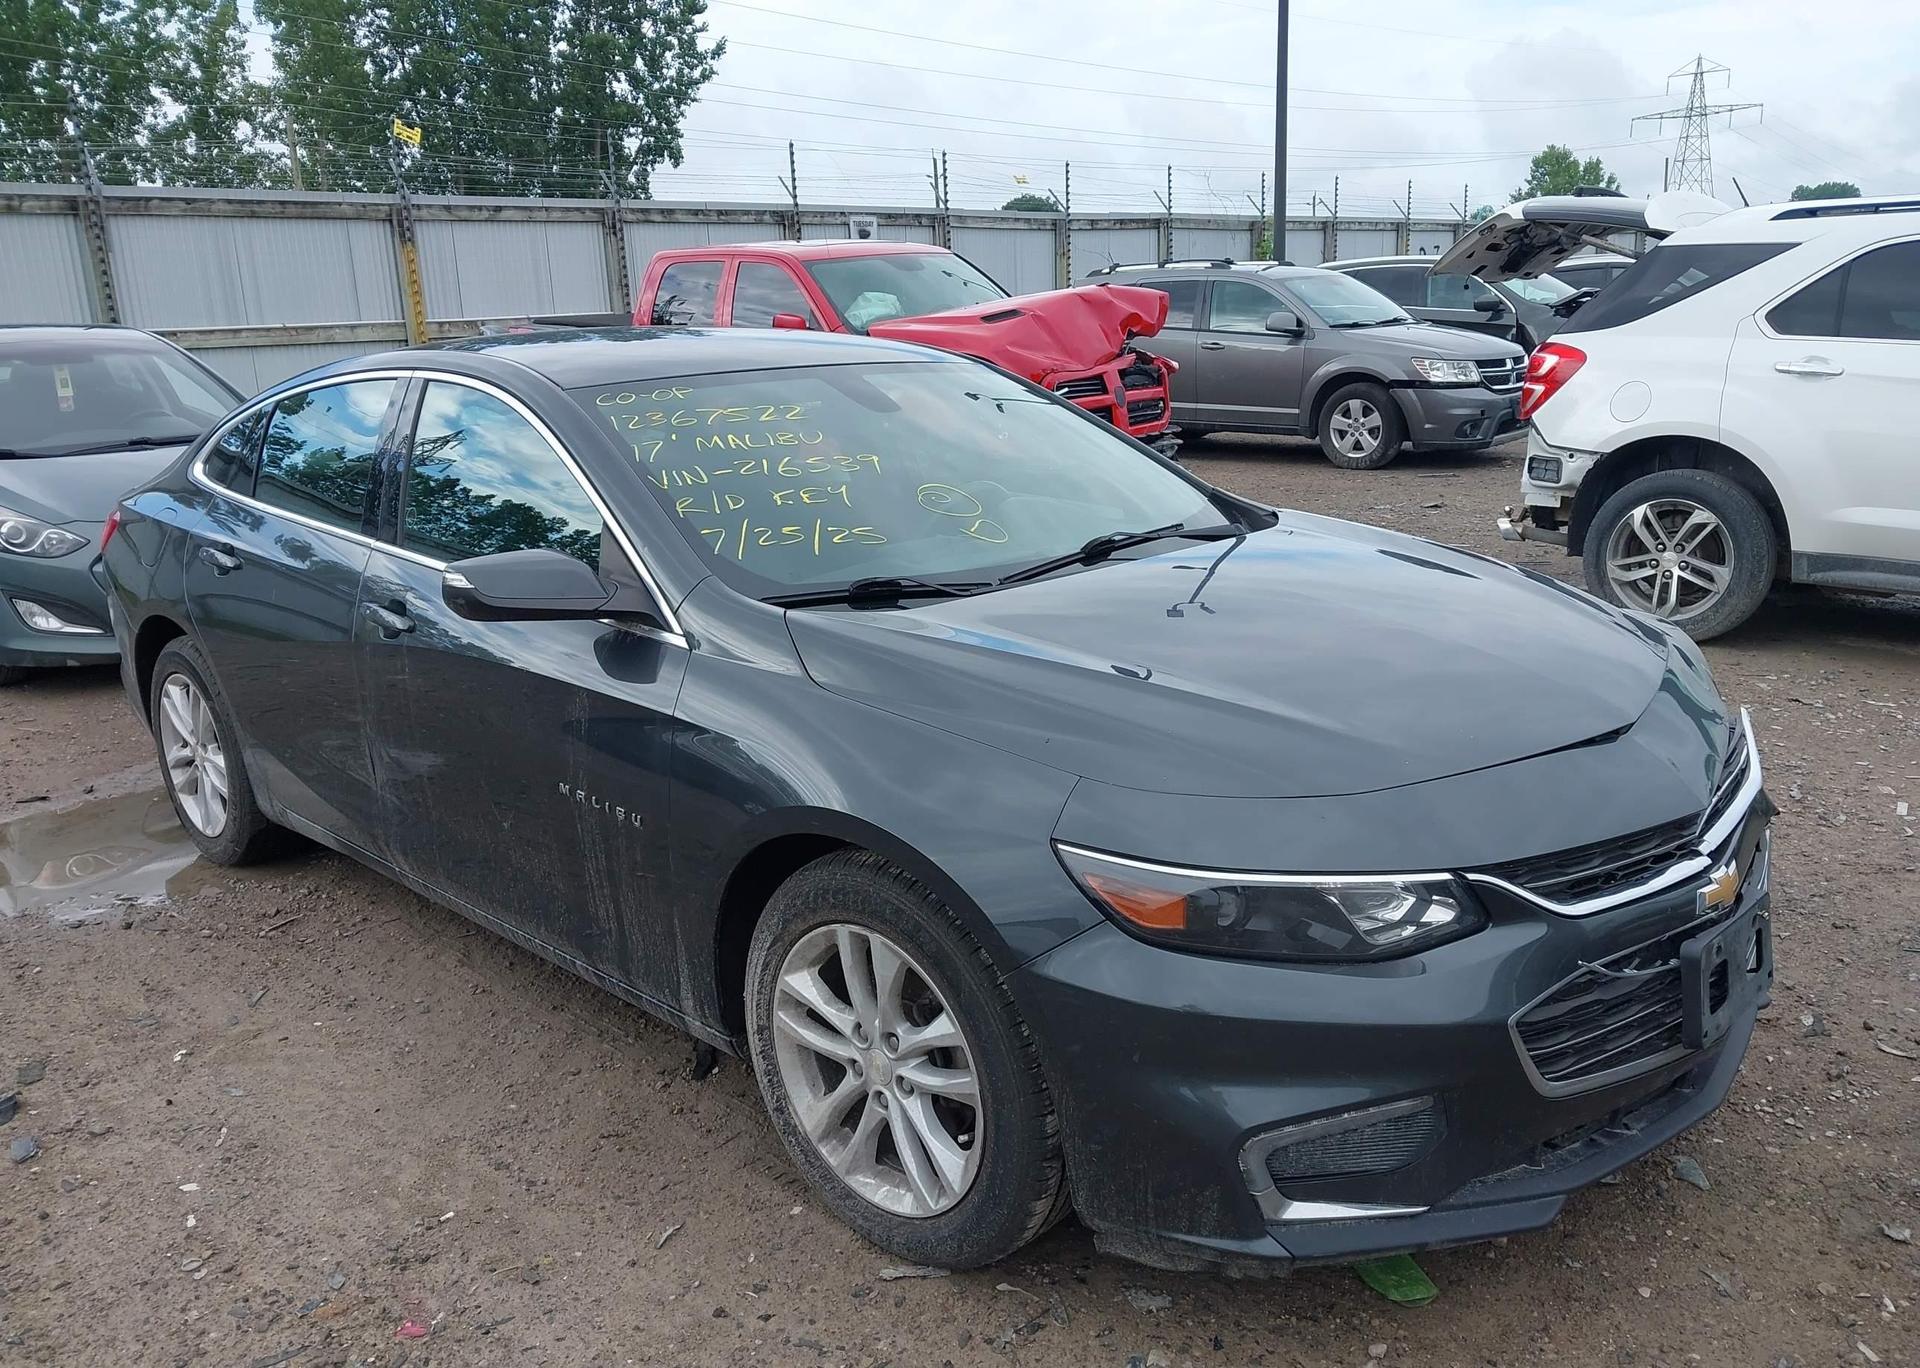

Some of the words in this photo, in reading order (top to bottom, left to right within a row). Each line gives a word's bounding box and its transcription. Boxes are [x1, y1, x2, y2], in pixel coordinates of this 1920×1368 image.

[852, 220, 874, 228] TUESDAY
[596, 386, 694, 406] CO-OP
[610, 405, 809, 433] 12367522
[696, 430, 823, 452] MALIBU
[647, 453, 881, 490] VIN-216539
[768, 484, 853, 508] KEY
[700, 518, 888, 561] 7/25/25
[558, 782, 642, 828] MALIBU
